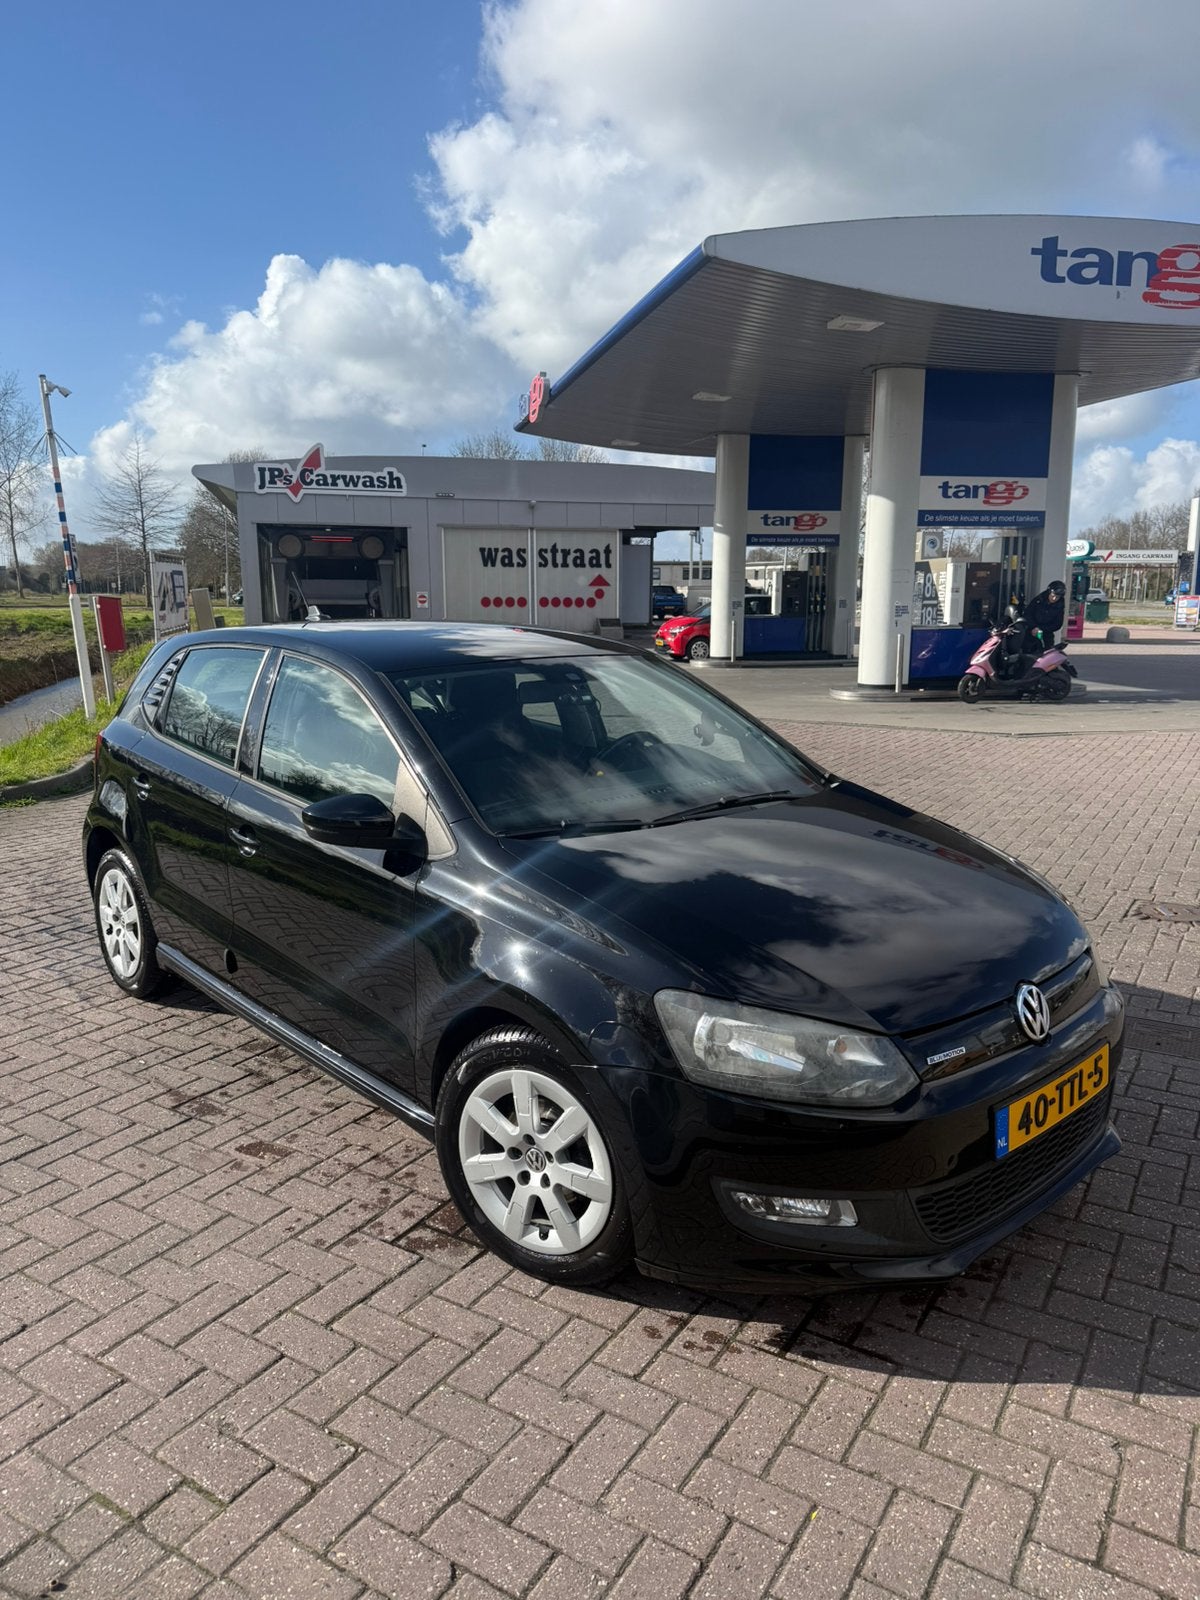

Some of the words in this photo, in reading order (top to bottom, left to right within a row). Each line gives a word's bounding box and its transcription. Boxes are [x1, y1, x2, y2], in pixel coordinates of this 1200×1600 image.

[299, 467, 403, 490] Carwash
[938, 481, 1030, 506] tango
[761, 513, 828, 531] tango
[924, 514, 934, 522] De
[935, 514, 959, 522] slimste
[960, 514, 979, 522] keuze
[980, 514, 990, 522] als
[990, 514, 998, 523] je
[999, 514, 1015, 522] moet
[479, 547, 527, 568] was
[538, 542, 612, 568] straat
[1018, 1054, 1103, 1135] 40-TTL-5
[997, 1137, 1008, 1149] NL
